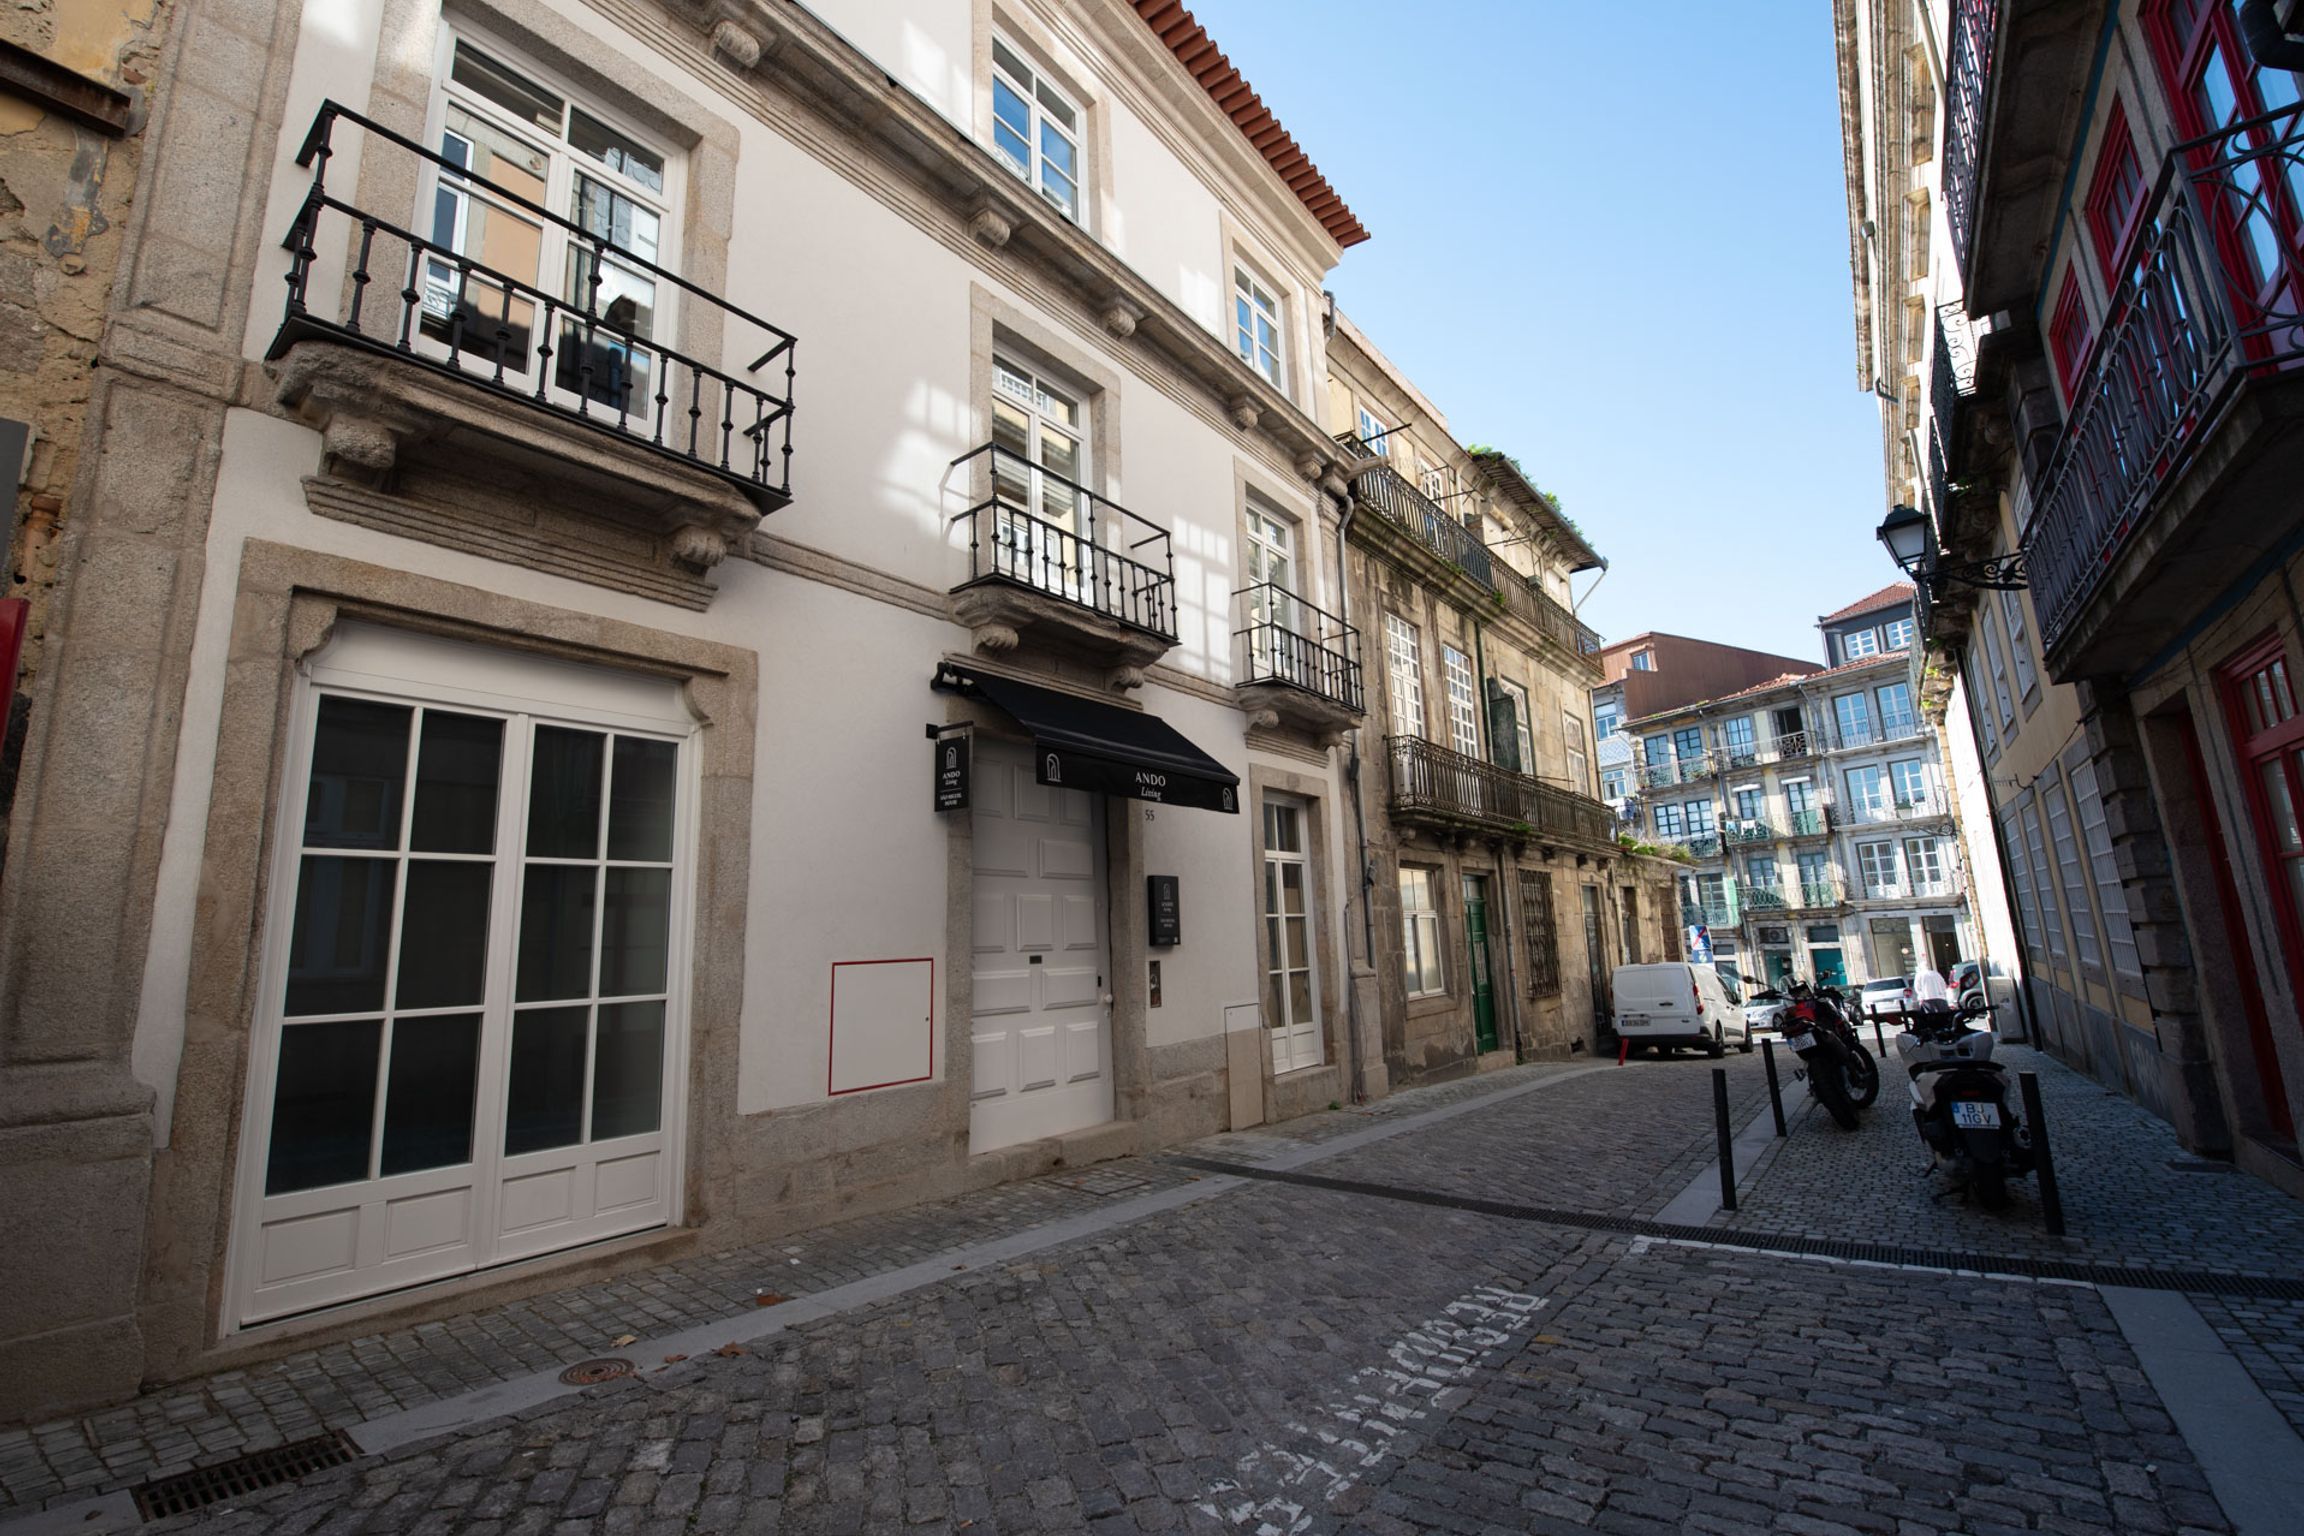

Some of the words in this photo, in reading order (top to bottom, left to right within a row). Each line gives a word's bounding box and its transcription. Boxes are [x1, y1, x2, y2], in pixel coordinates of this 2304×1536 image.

[942, 771, 961, 780] ANDO
[1135, 771, 1166, 787] ANDO
[1140, 786, 1162, 802] Living
[1145, 809, 1155, 821] 55
[1965, 1103, 1985, 1114] BJ
[1962, 1113, 1992, 1124] 11GV
